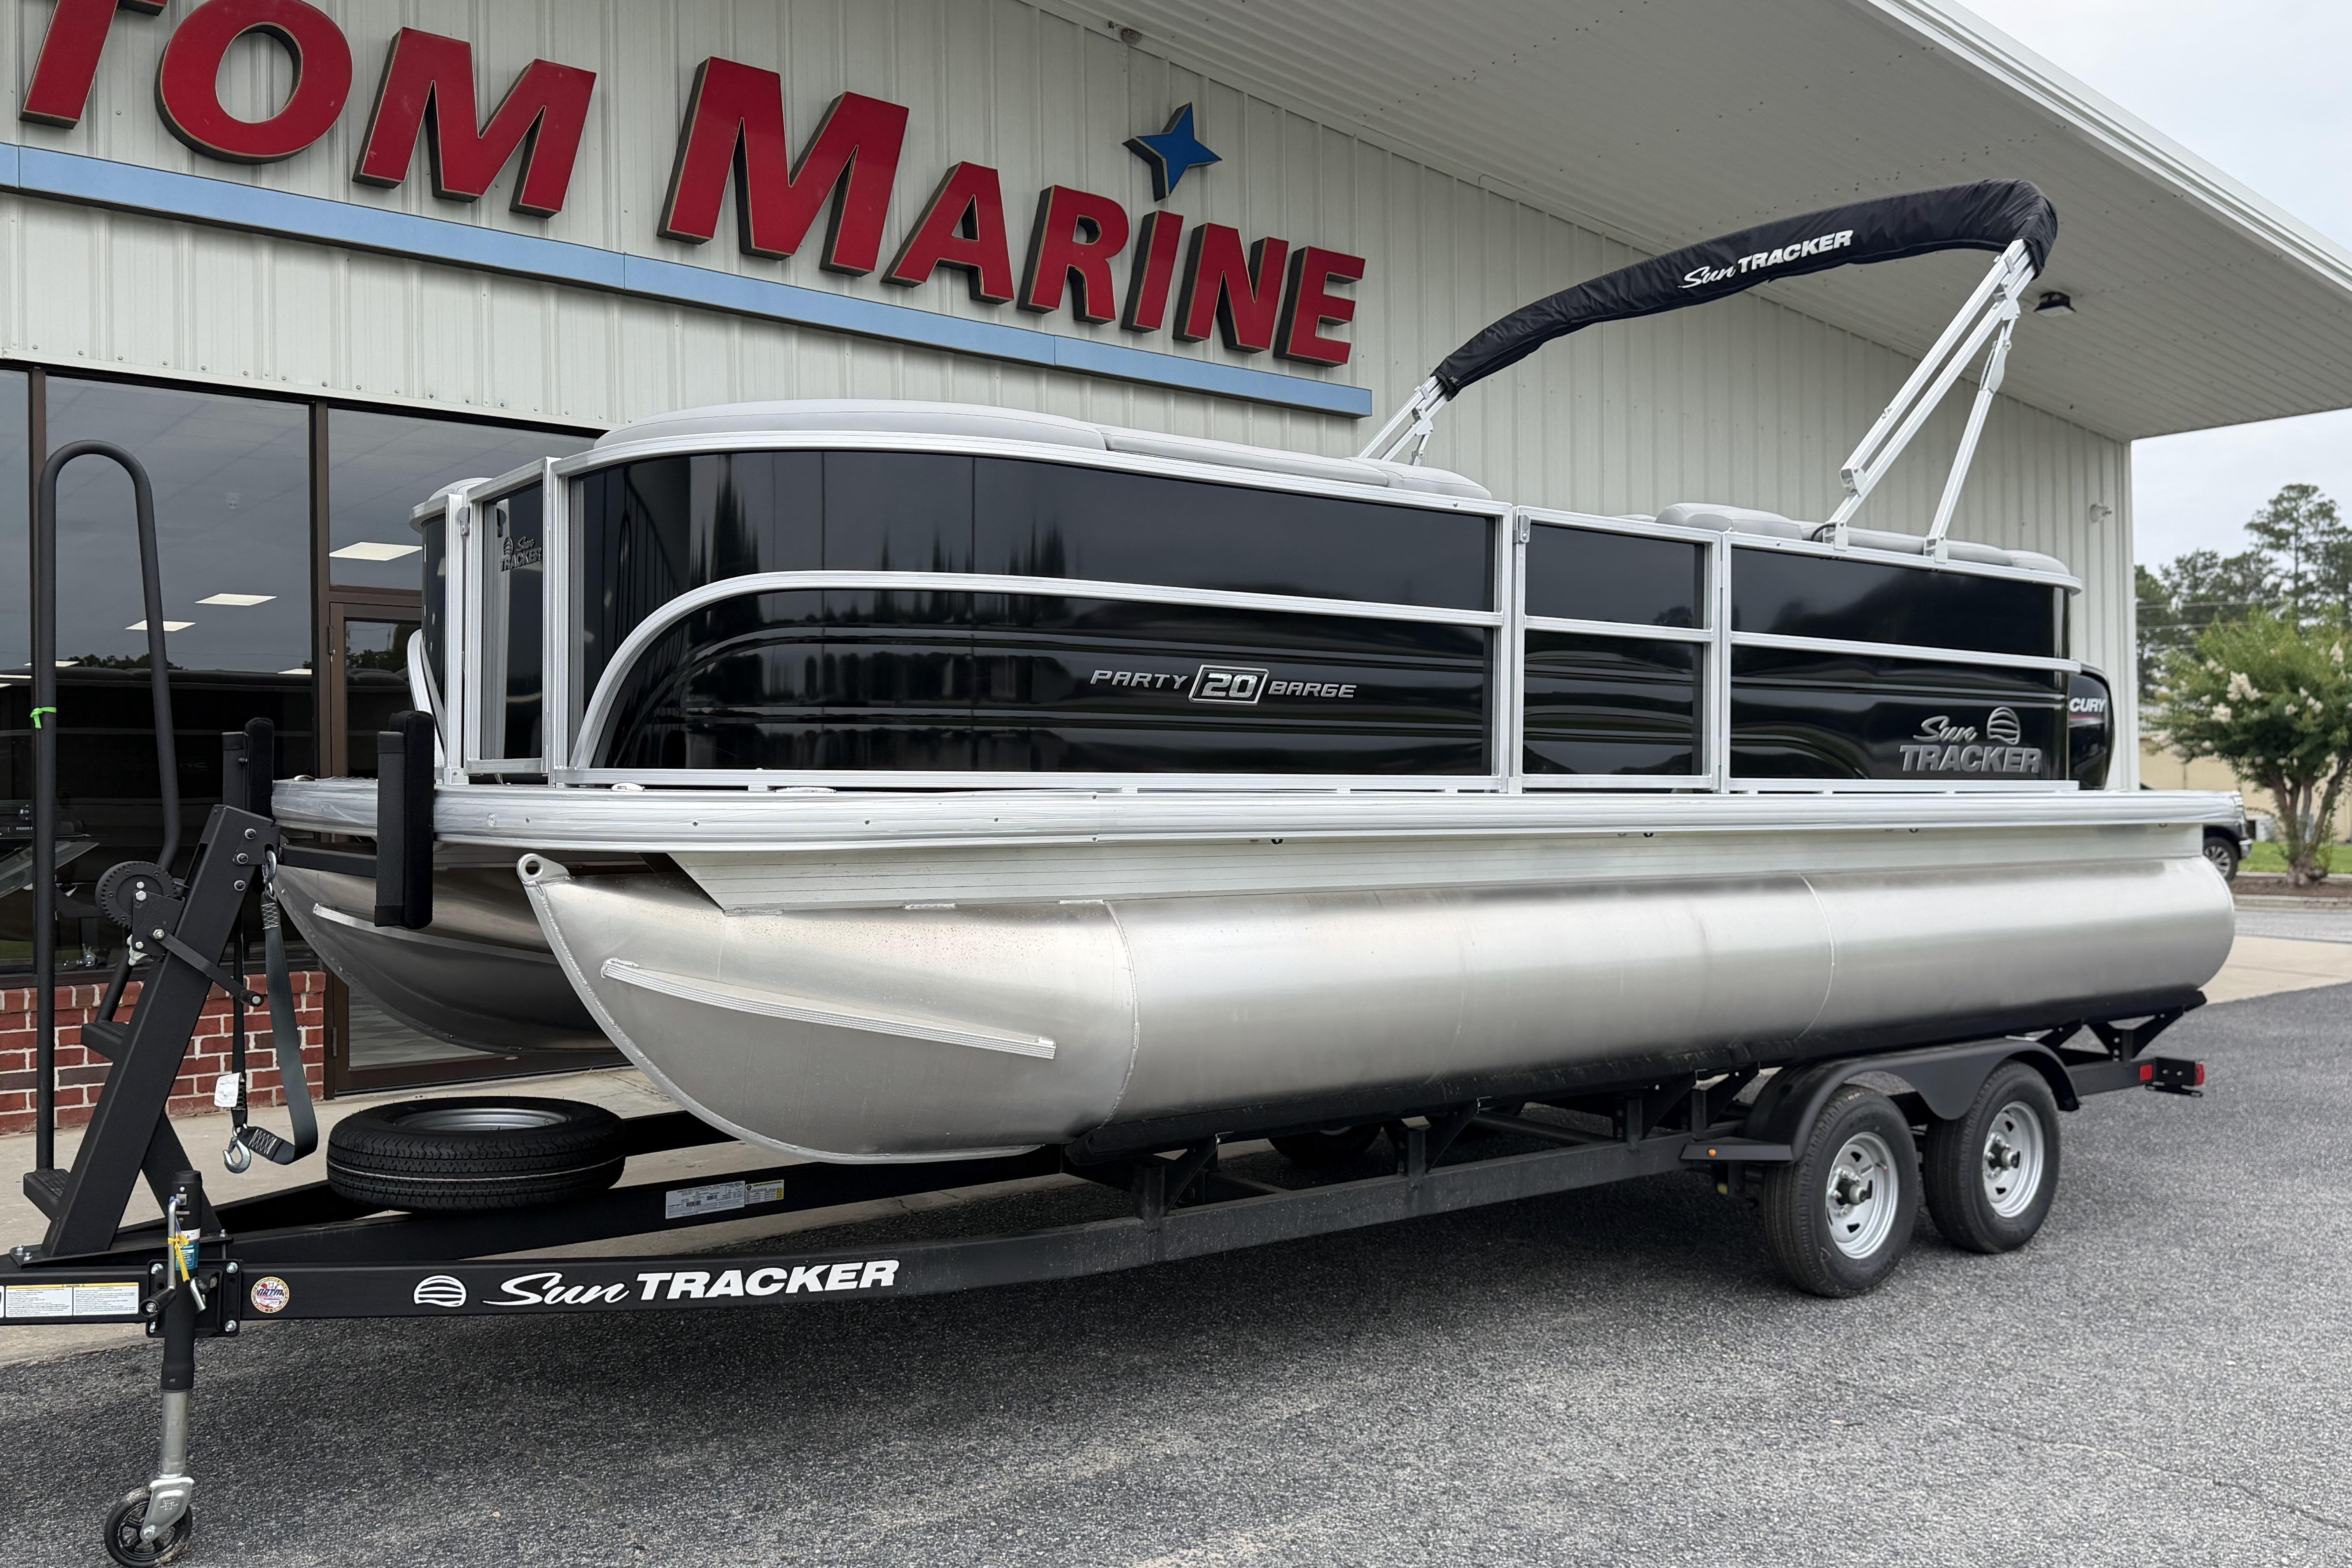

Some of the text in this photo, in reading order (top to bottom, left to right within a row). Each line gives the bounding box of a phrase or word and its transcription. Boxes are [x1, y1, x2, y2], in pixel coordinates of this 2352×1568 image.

[658, 56, 1365, 368] MARINE
[1678, 230, 1853, 288] Sun TRACKER
[516, 536, 534, 552] Sun
[499, 547, 541, 572] TRACKER
[1090, 670, 1357, 698] PARTY 20 BARGE
[1913, 715, 1978, 742] Sun
[1899, 744, 2042, 774] TRACKER
[483, 1260, 900, 1306] Sun TRACKER
